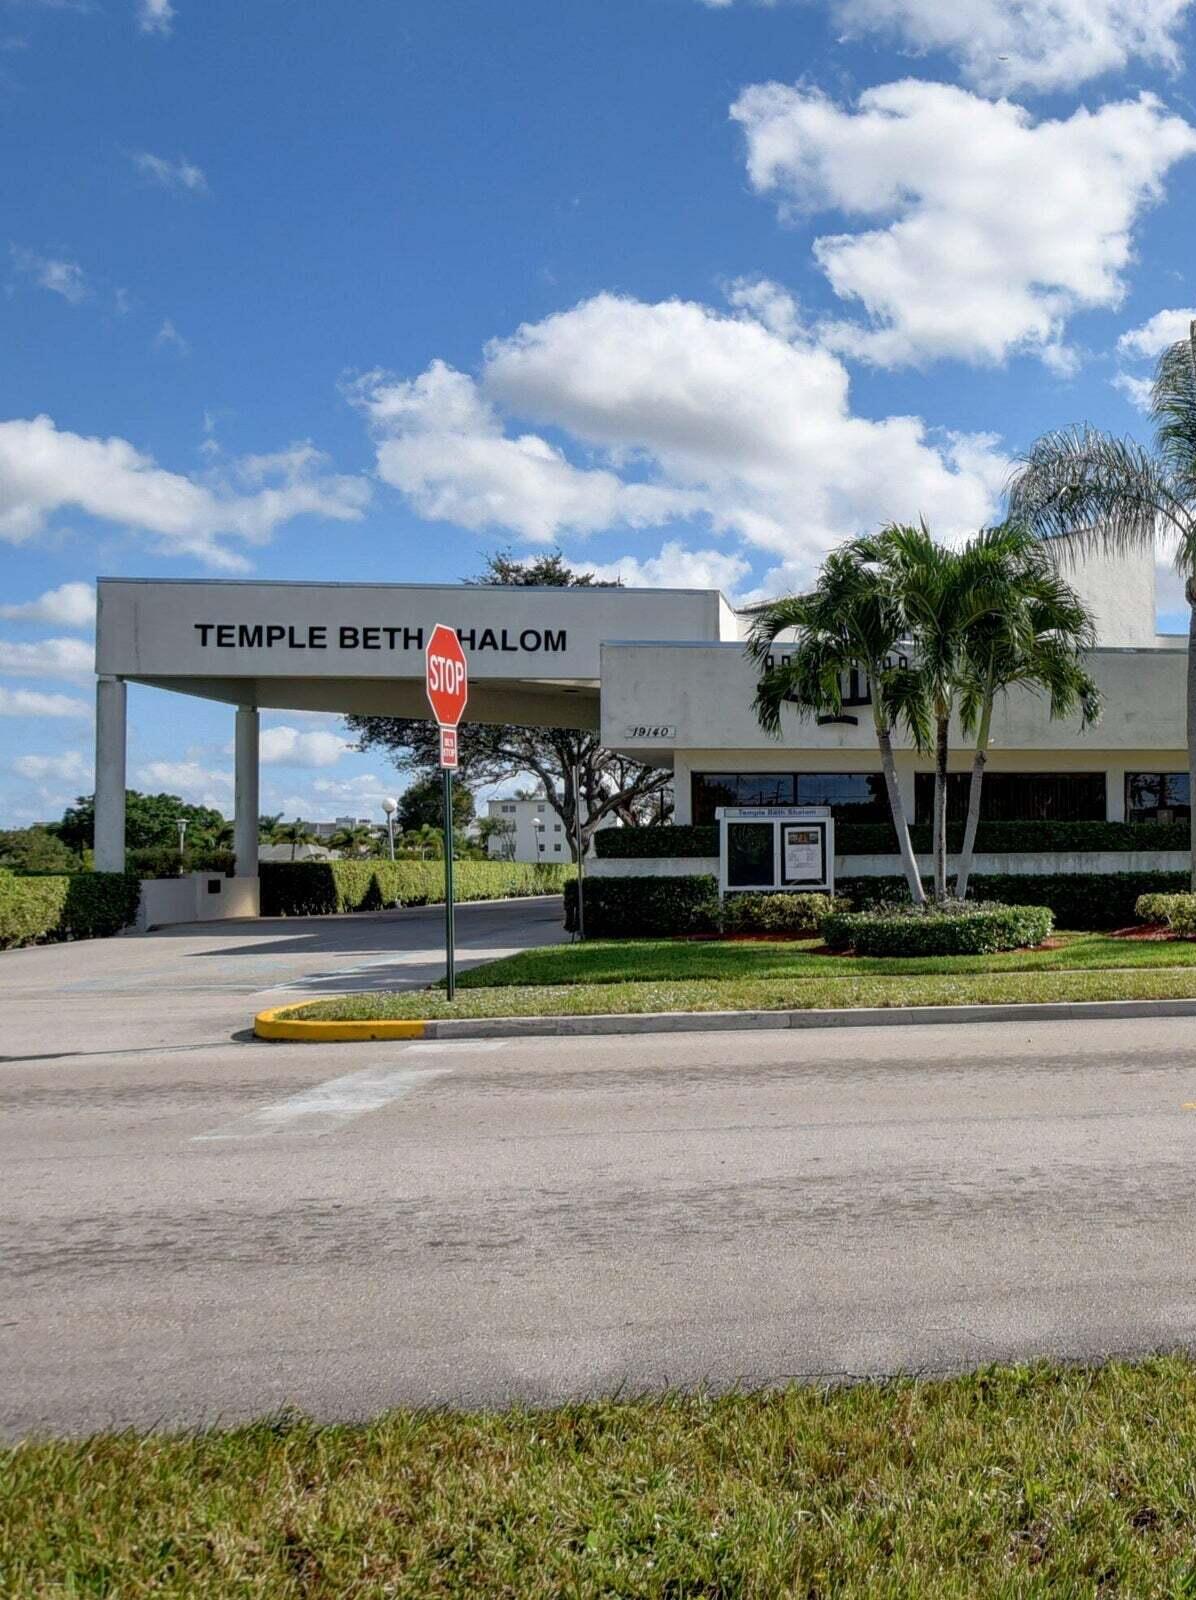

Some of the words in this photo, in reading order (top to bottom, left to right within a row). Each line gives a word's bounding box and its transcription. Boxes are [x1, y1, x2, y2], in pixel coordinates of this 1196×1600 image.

[194, 624, 327, 649] TEMPLE
[339, 626, 423, 650] BETH
[457, 629, 567, 652] HALOM
[430, 655, 464, 696] STOP
[632, 727, 668, 737] 19140
[739, 808, 765, 817] Temple
[788, 808, 816, 816] Shalom
